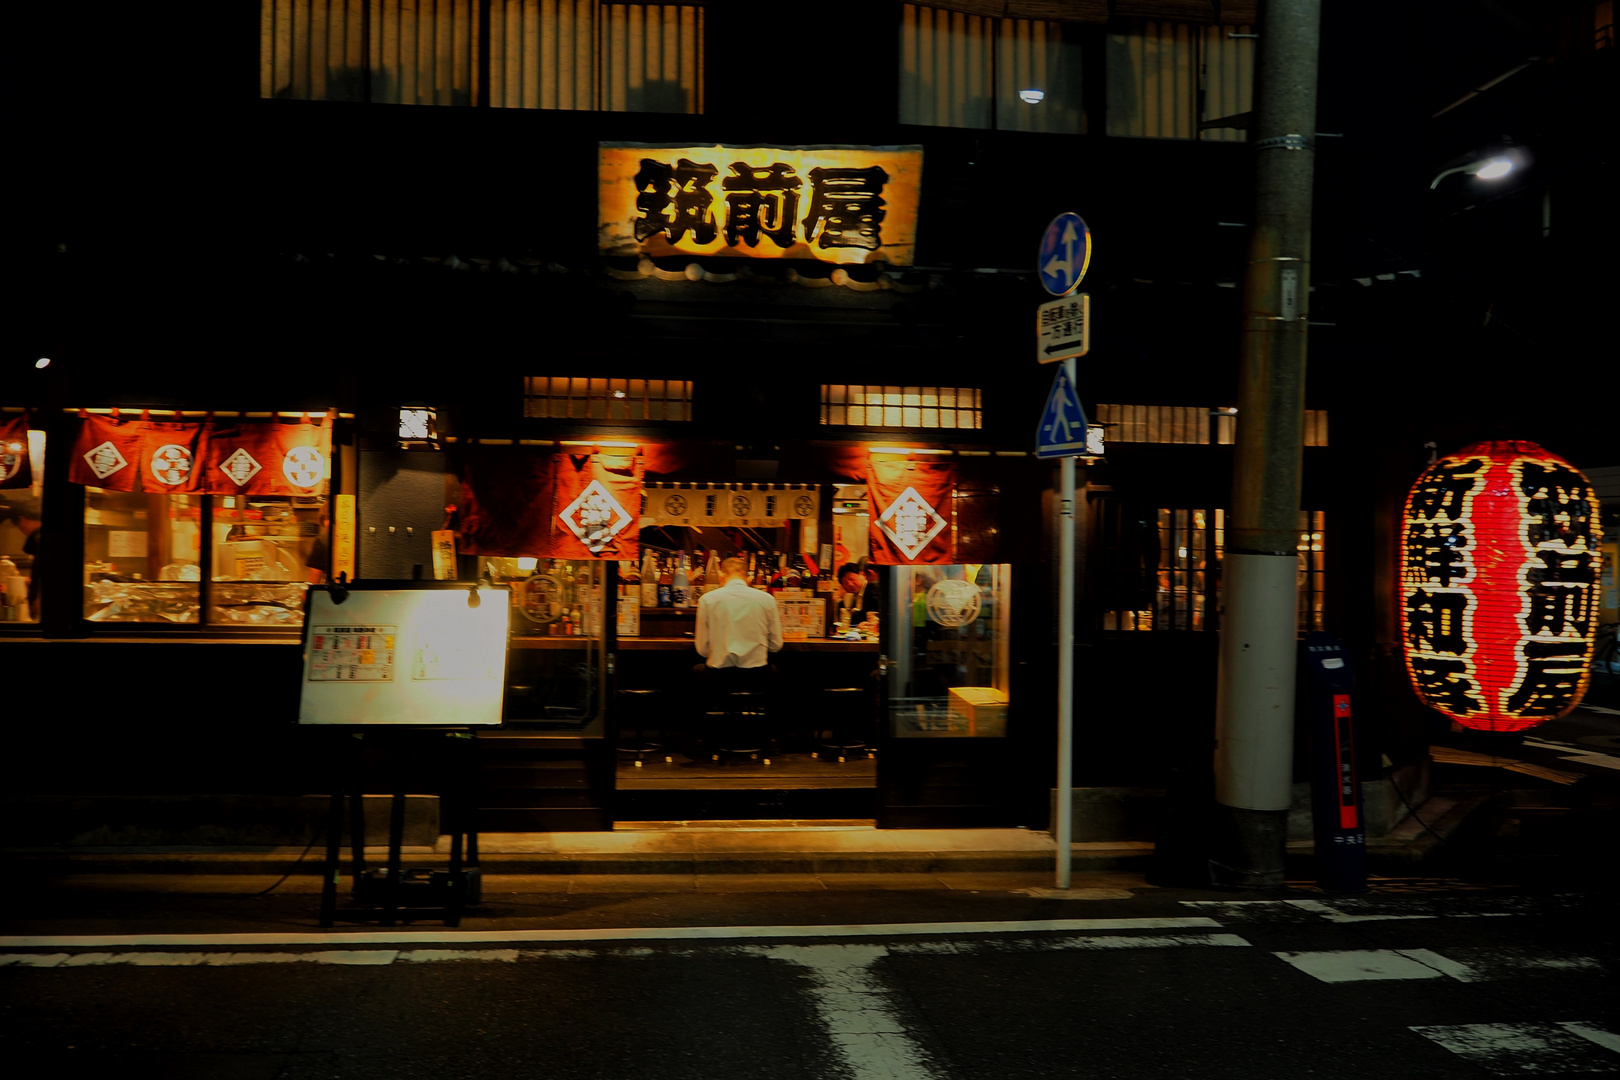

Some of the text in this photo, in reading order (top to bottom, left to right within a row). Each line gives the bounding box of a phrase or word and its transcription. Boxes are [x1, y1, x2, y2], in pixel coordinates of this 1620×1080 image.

[634, 157, 889, 250] 筑前屋
[1041, 318, 1083, 339] 一方通行
[1333, 834, 1364, 845] 中央区
